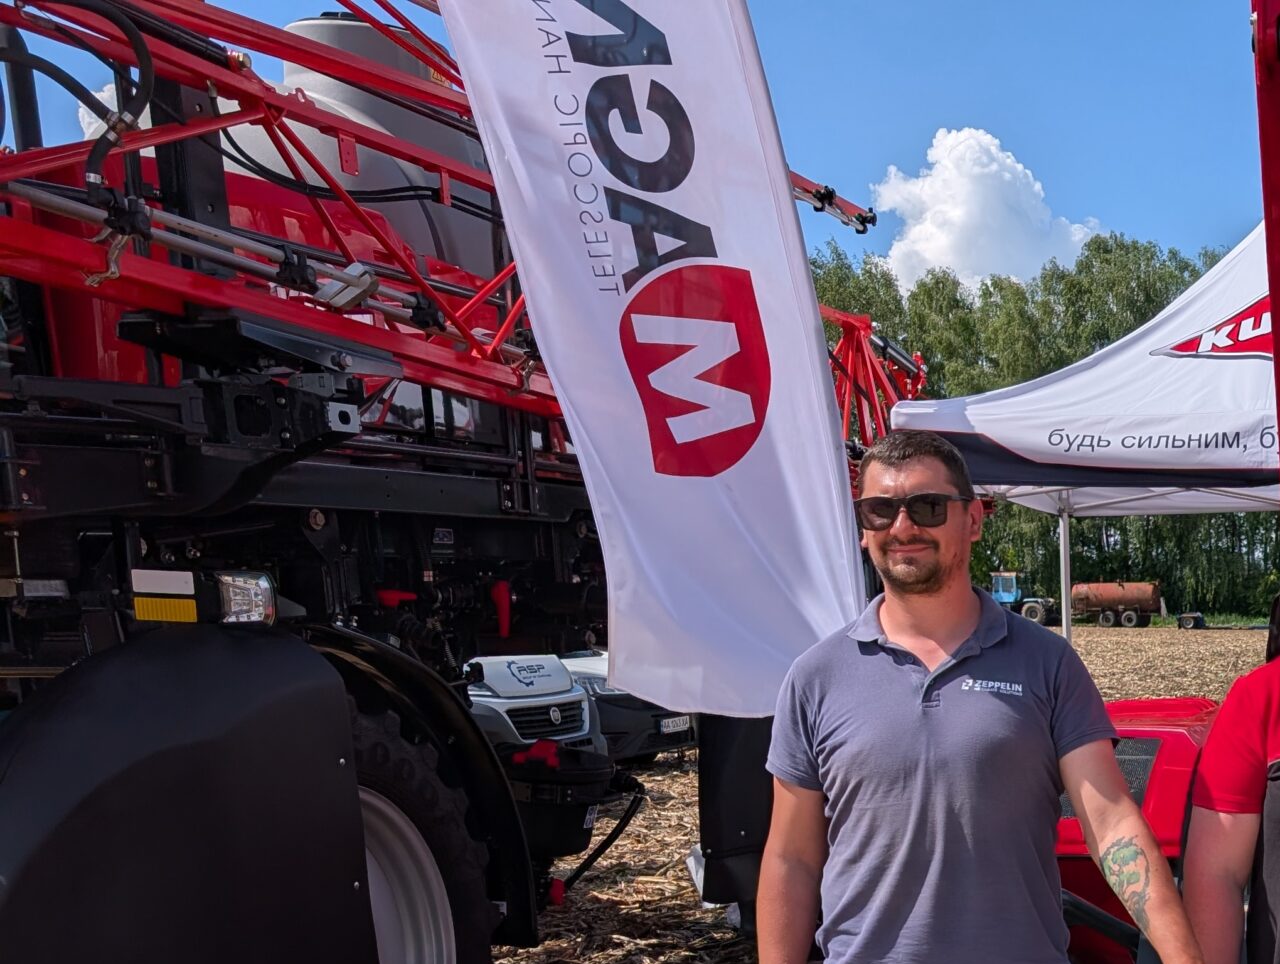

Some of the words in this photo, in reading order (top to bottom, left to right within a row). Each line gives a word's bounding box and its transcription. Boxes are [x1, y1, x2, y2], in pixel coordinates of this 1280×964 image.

[1048, 428, 1112, 452] будь
[1121, 431, 1248, 453] сильним,
[974, 680, 1023, 692] ZEPPELIN
